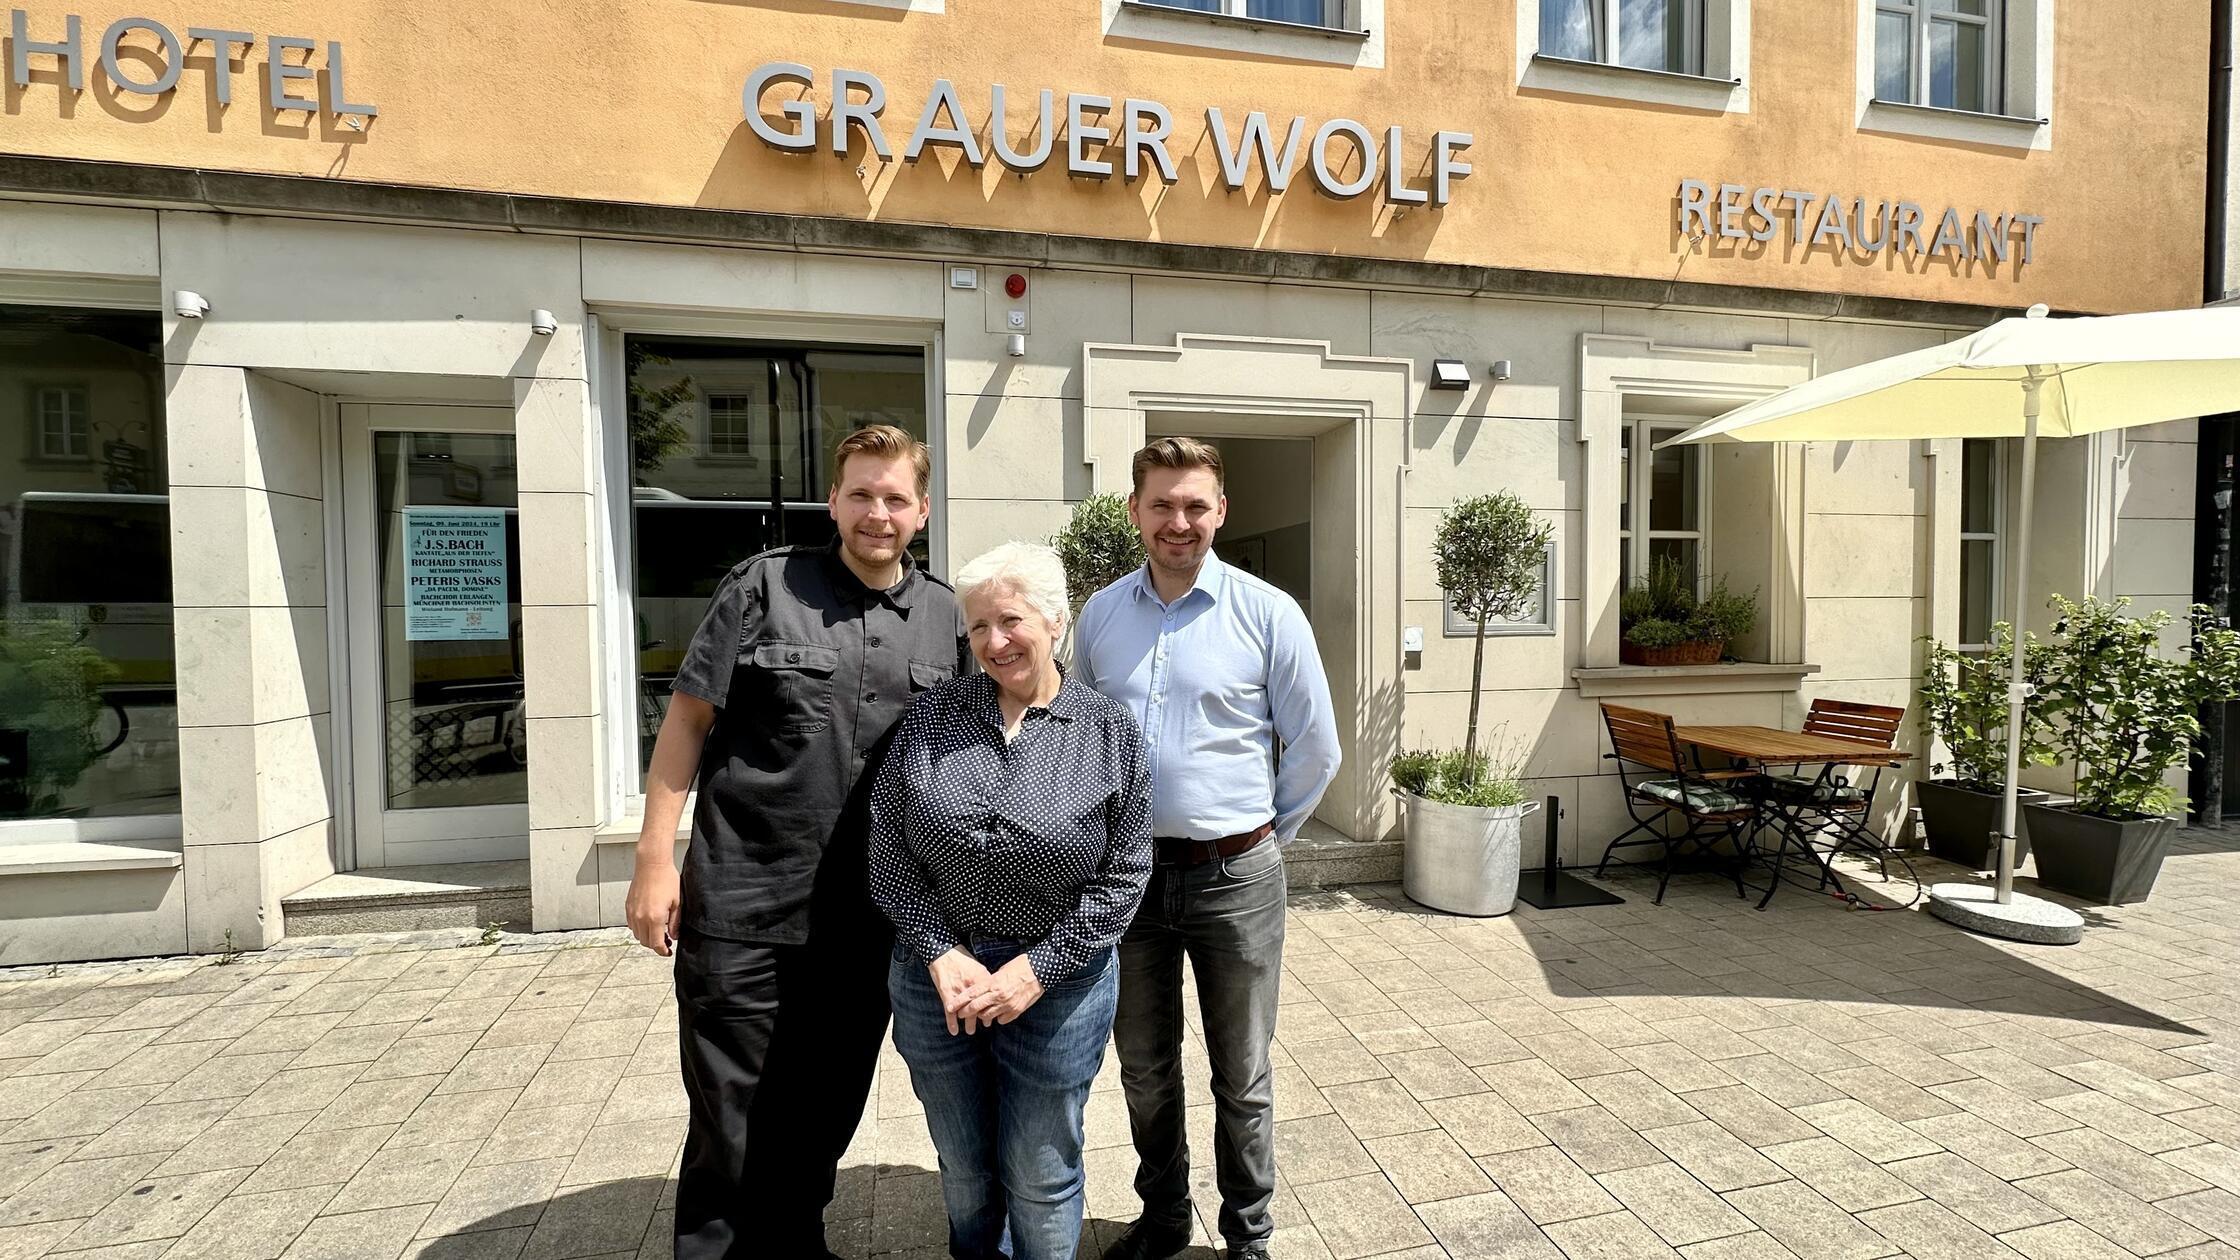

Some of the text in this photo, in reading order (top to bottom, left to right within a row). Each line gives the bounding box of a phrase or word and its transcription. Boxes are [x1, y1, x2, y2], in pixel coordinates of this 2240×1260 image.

[11, 8, 378, 117] HOTEL
[742, 61, 1475, 211] GRAUER WOLF
[1680, 178, 2044, 265] RESTAURANT
[422, 528, 437, 536] FÜR
[424, 540, 484, 550] J.S.BACH
[411, 559, 502, 567] RICHARD STRAUSS
[411, 577, 501, 586] PETERIS VASKS
